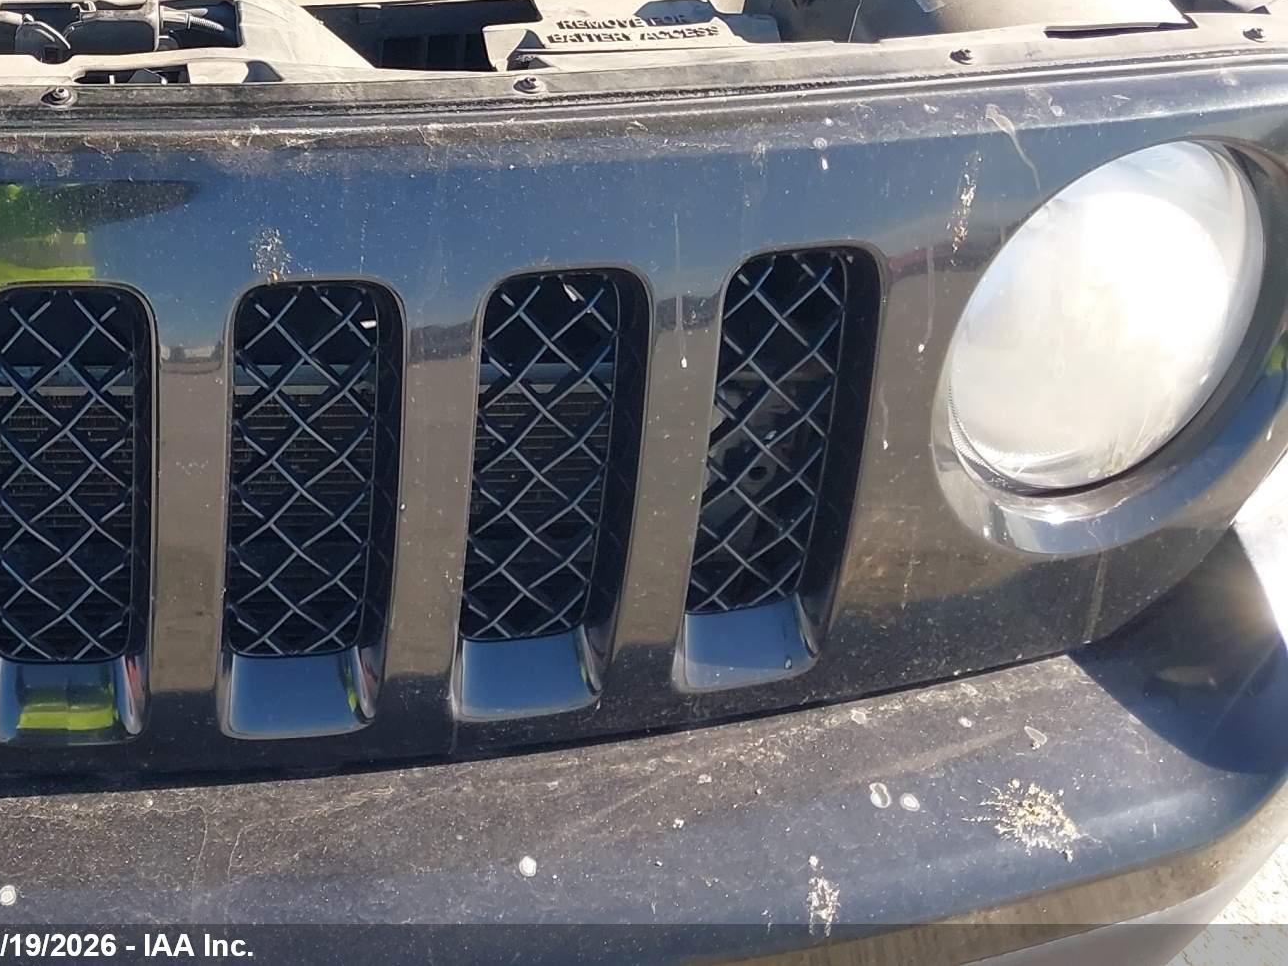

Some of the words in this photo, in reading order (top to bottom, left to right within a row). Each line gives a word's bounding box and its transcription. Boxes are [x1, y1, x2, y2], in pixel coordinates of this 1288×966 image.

[556, 17, 645, 30] REMOVE
[648, 14, 687, 27] FOR
[546, 32, 631, 44] BATTERY
[639, 26, 720, 41] ACCESS
